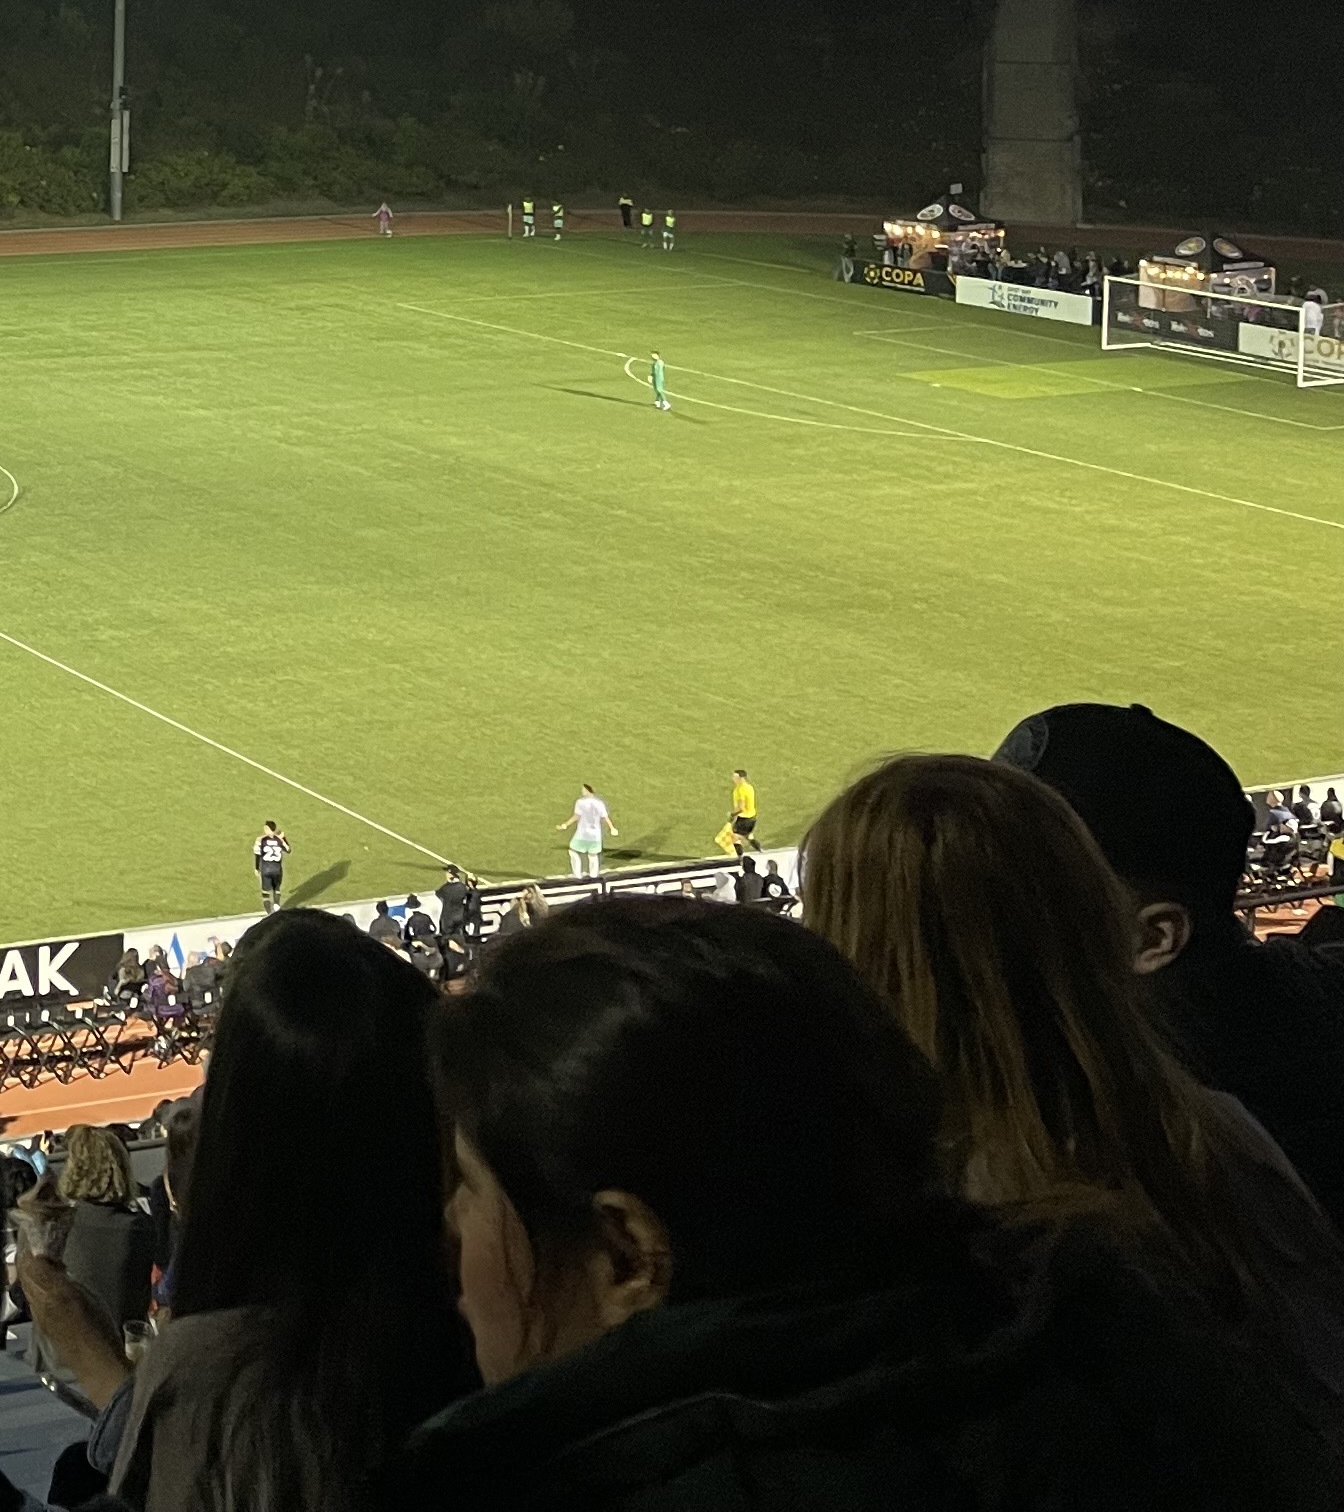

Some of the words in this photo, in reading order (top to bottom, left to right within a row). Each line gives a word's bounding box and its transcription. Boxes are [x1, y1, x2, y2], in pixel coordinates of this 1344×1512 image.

[881, 266, 925, 287] COPA
[1007, 293, 1058, 308] COMMUNITY
[1007, 302, 1039, 316] ENERGY
[262, 845, 282, 862] 23
